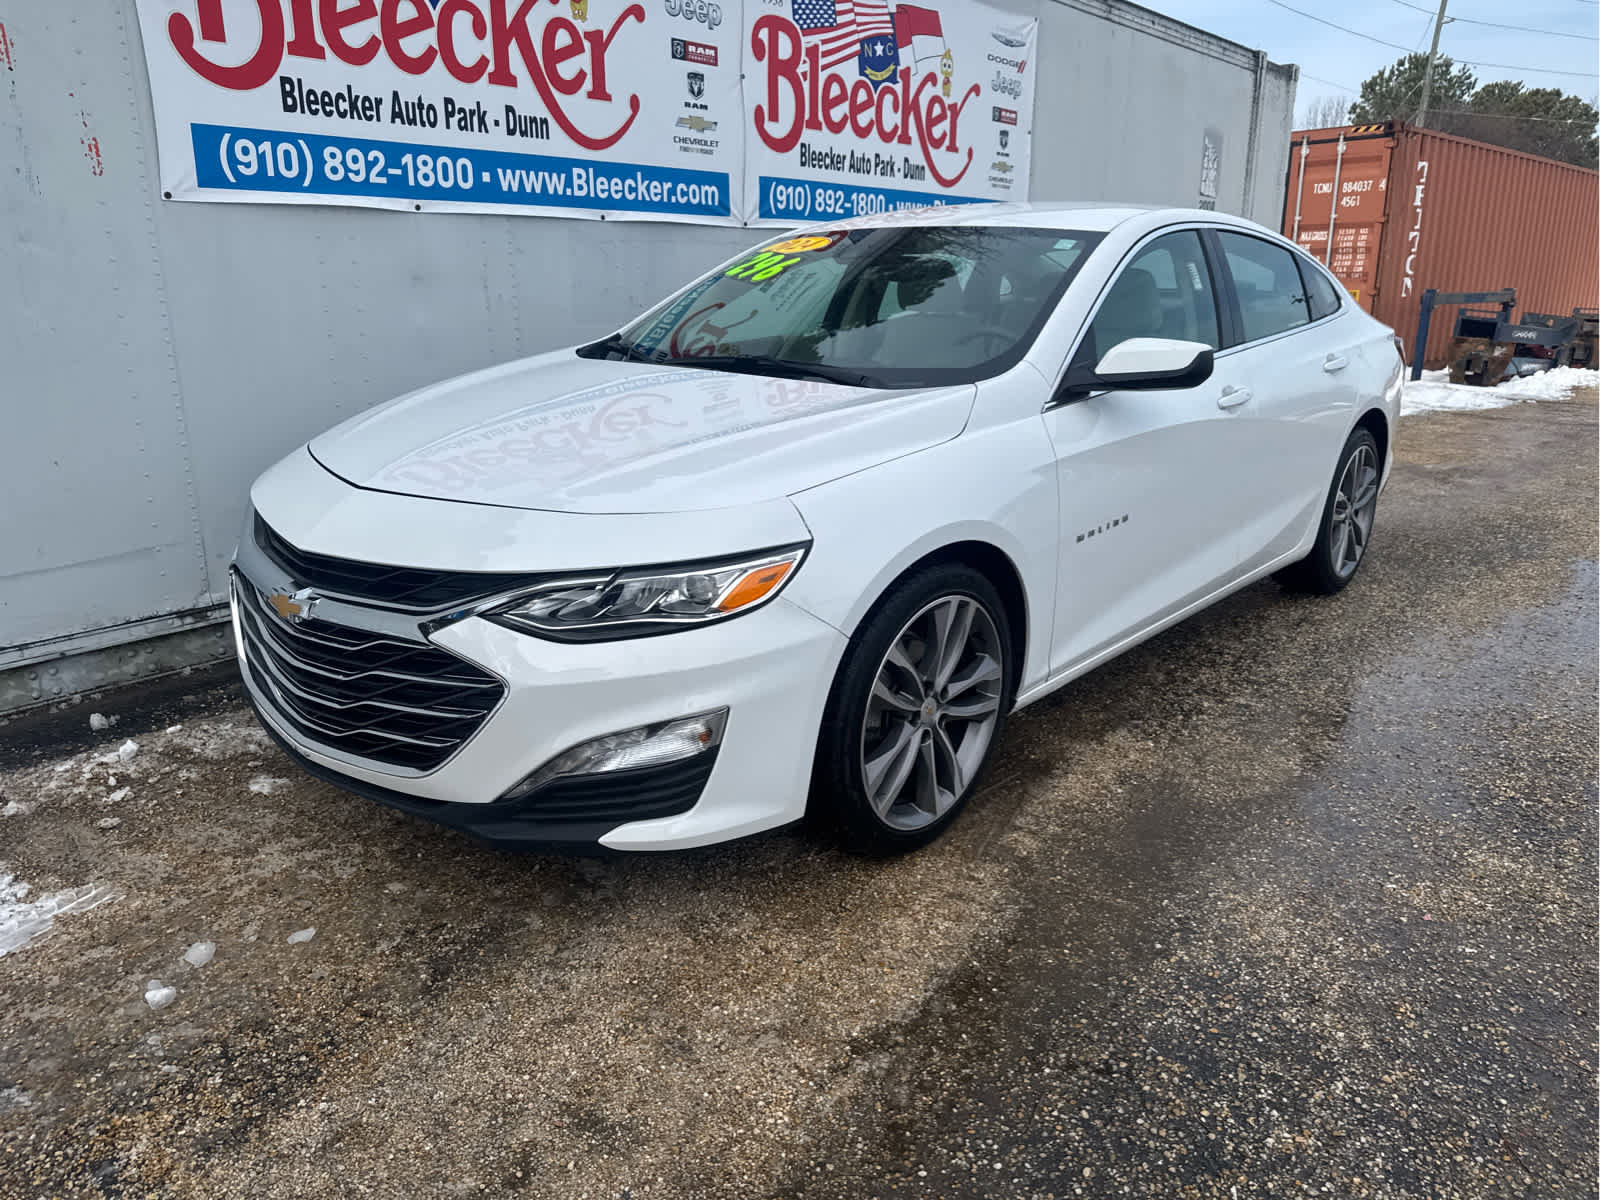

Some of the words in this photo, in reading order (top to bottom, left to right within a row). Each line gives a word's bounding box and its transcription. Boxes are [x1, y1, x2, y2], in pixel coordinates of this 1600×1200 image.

[279, 75, 383, 123] Bleecker
[390, 90, 438, 129] Auto
[443, 96, 489, 134] Park
[504, 104, 550, 140] Dunn
[673, 135, 719, 147] CHEVROLET
[219, 133, 314, 186] (910)
[323, 146, 474, 190] 892-1800
[497, 167, 720, 206] www.Bleecker.com
[800, 142, 847, 172] Bleecker
[848, 149, 871, 175] Auto
[874, 153, 896, 177] Park
[904, 156, 926, 181] Dunn
[769, 181, 811, 216] (910)
[815, 188, 885, 216] 892-1800
